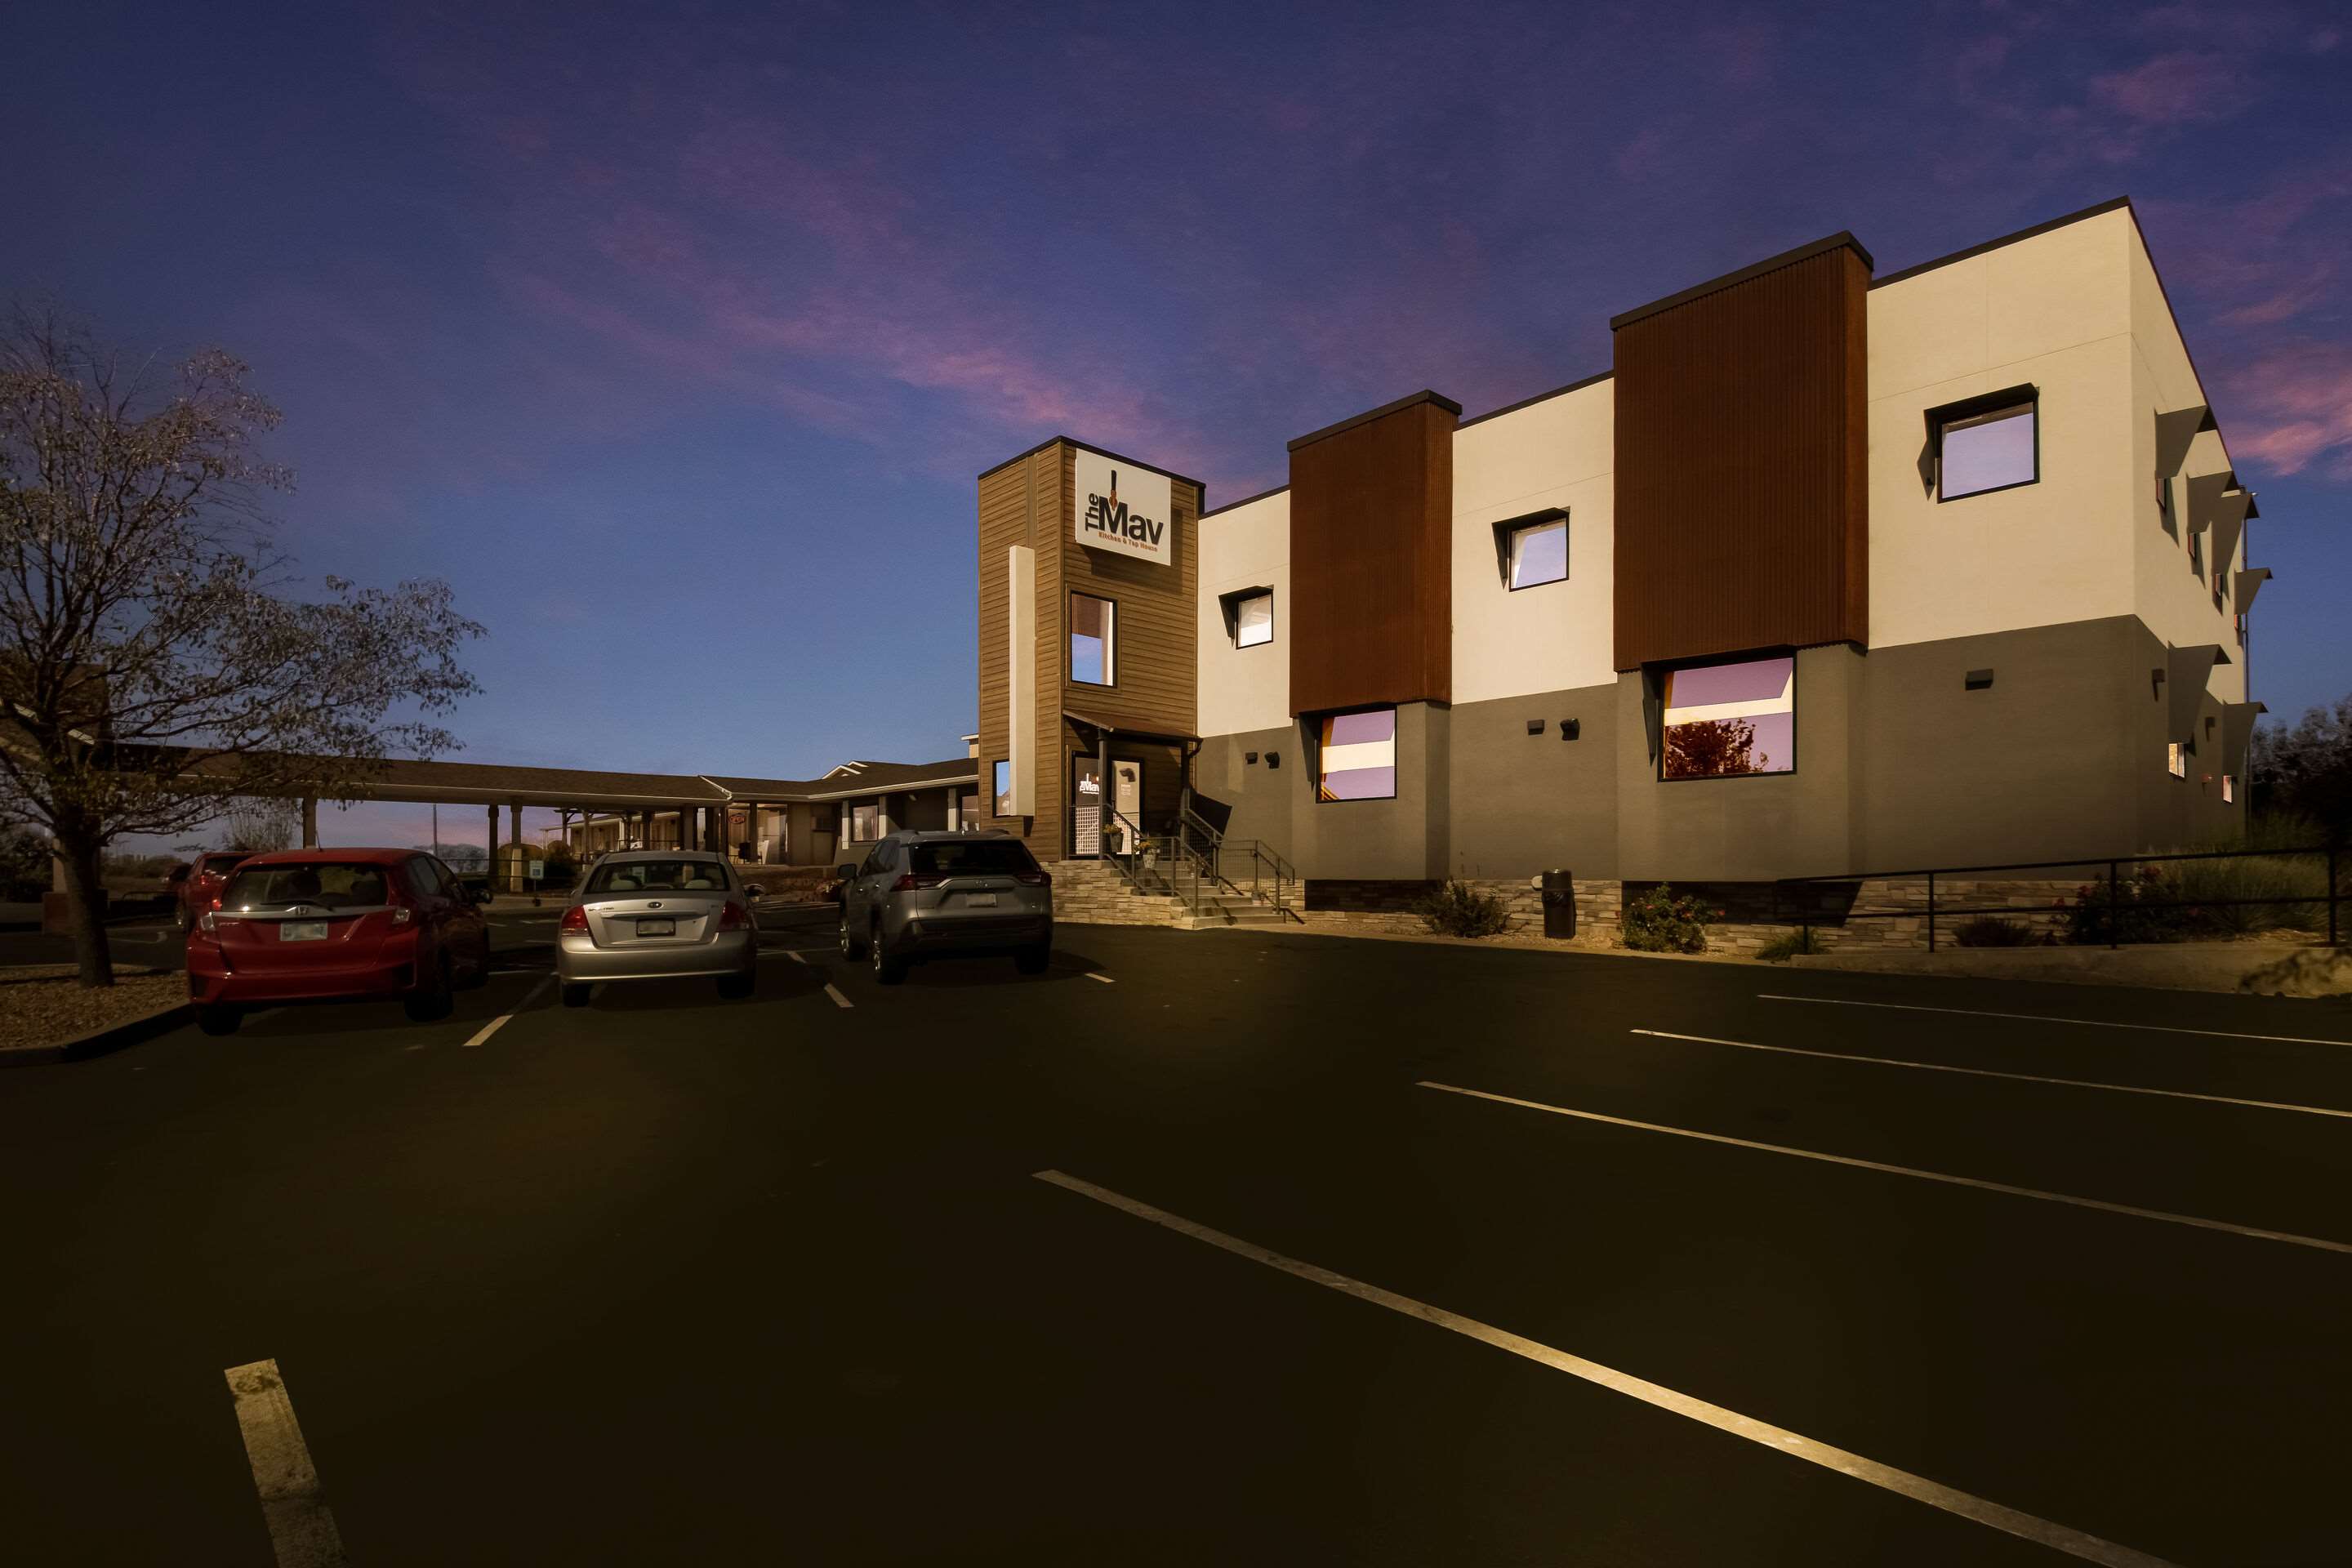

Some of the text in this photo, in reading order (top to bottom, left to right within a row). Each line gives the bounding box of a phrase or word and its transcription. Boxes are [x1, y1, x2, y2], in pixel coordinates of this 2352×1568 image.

[1085, 492, 1098, 532] The
[1098, 496, 1164, 546] Mav
[1098, 532, 1121, 542] Kitchen
[1129, 539, 1139, 548] Tap
